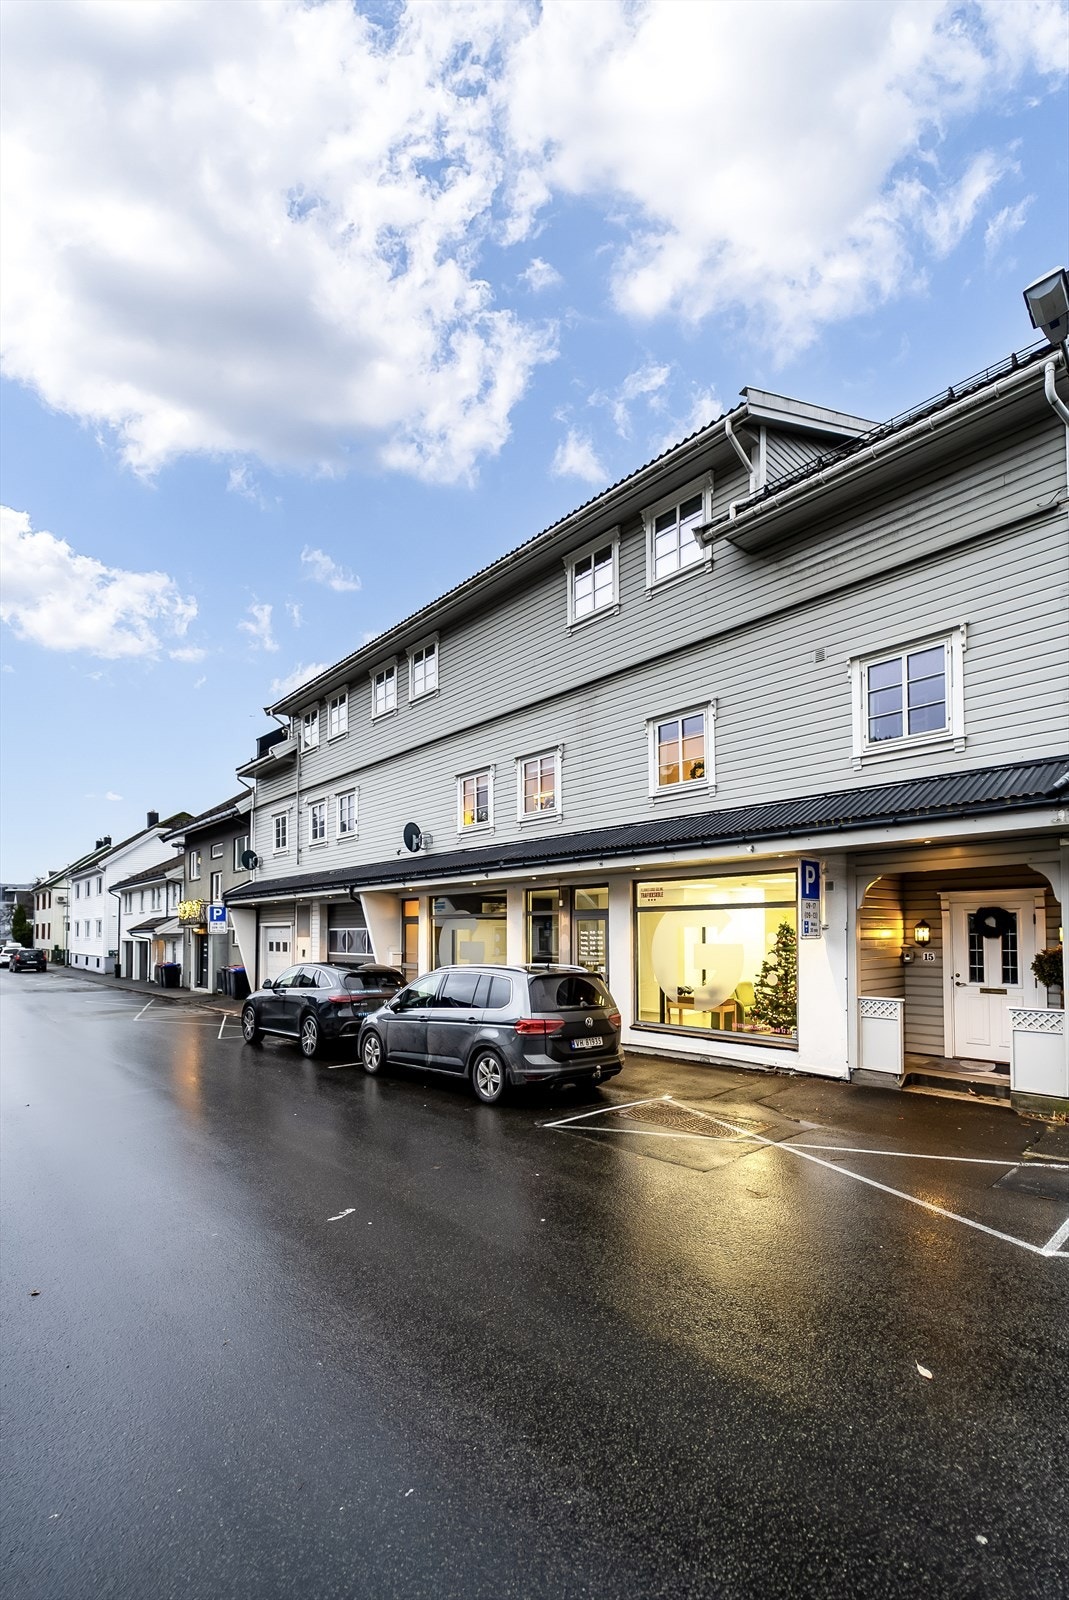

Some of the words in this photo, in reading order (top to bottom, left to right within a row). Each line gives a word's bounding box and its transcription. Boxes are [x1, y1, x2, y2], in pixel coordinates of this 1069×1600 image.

[805, 865, 816, 895] P
[213, 908, 222, 920] P
[924, 953, 934, 961] 15
